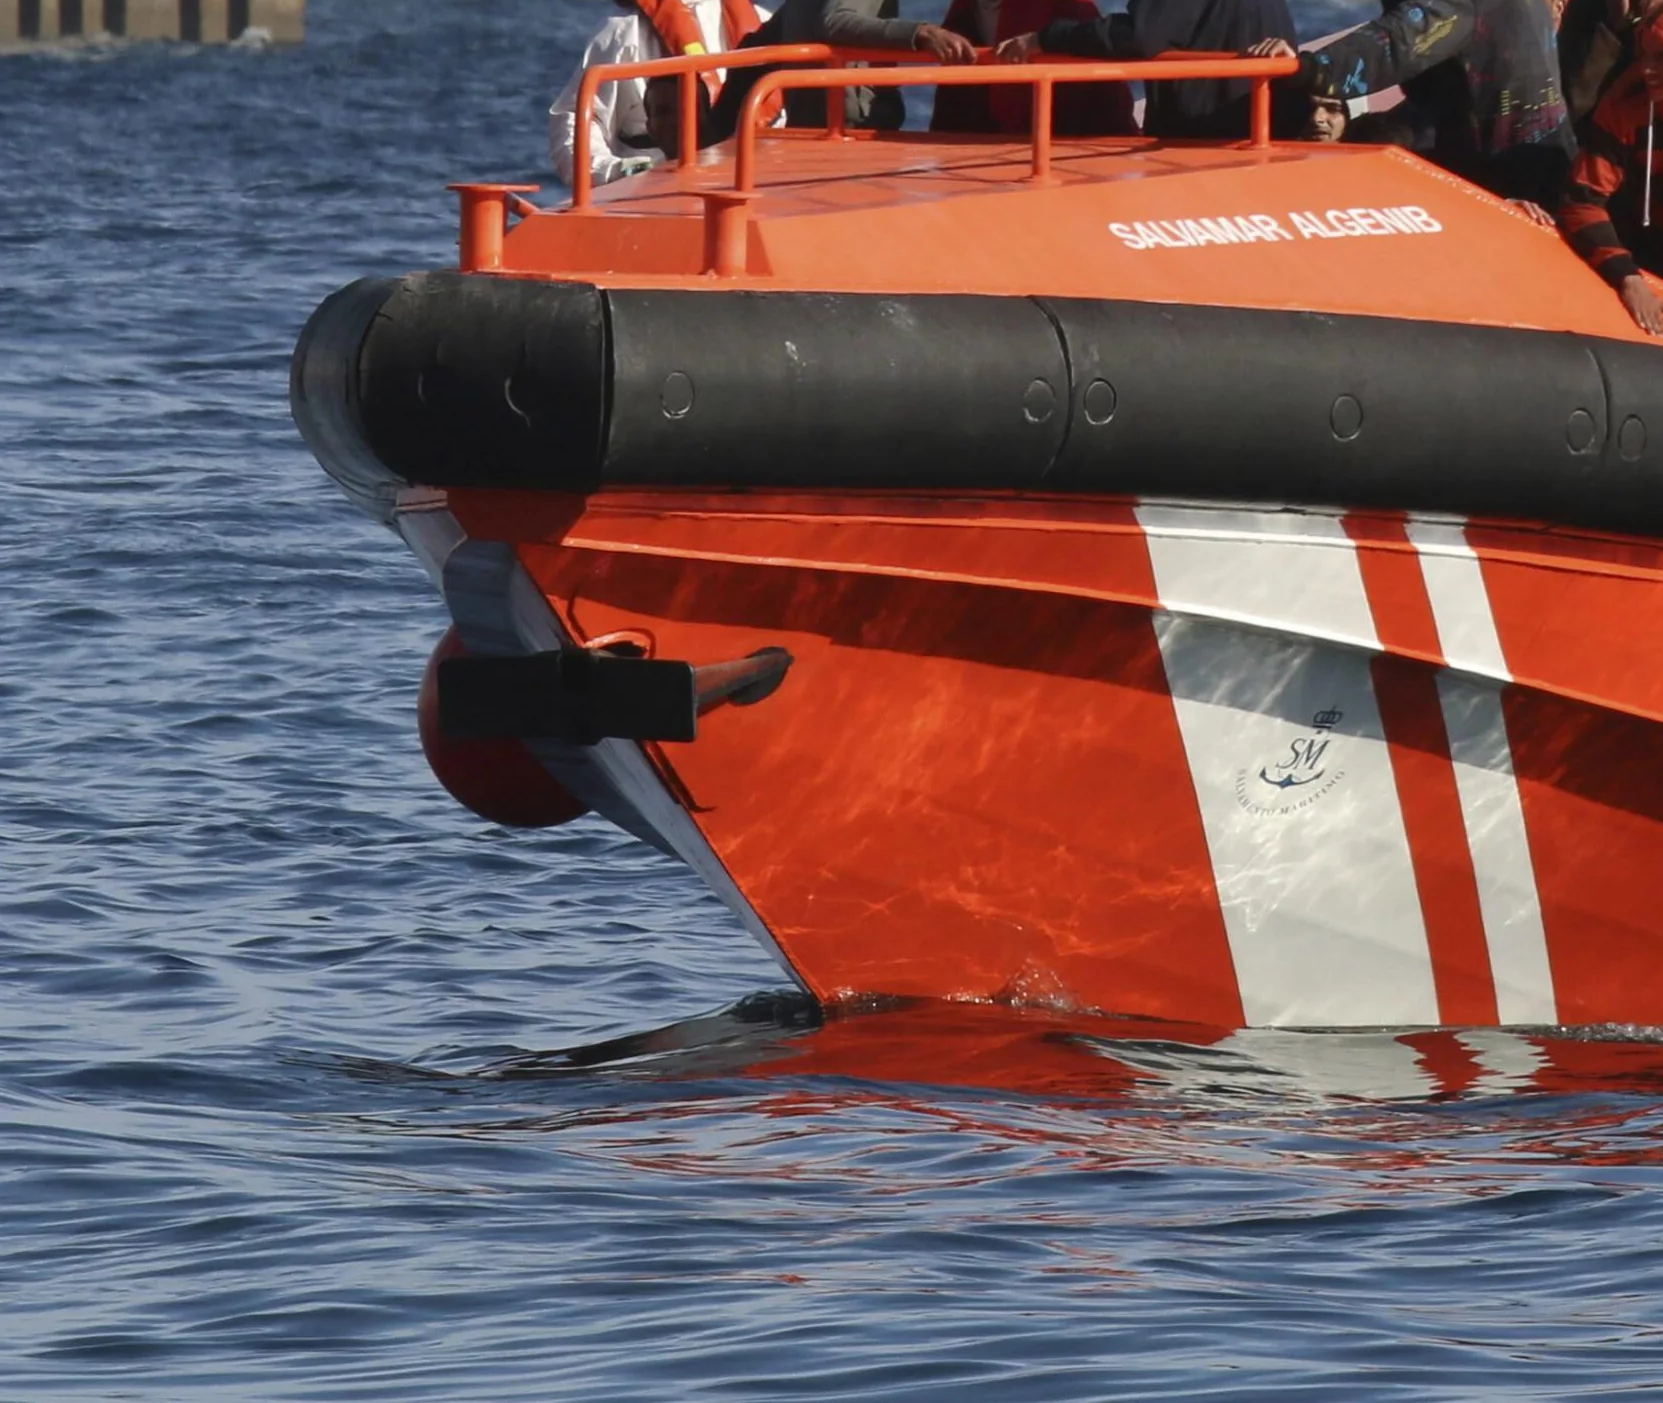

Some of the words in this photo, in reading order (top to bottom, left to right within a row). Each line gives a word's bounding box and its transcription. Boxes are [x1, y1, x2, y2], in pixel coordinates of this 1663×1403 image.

[1107, 213, 1294, 250] SALVAMAR
[1288, 205, 1443, 239] ALGENIB
[1275, 737, 1332, 771] SM
